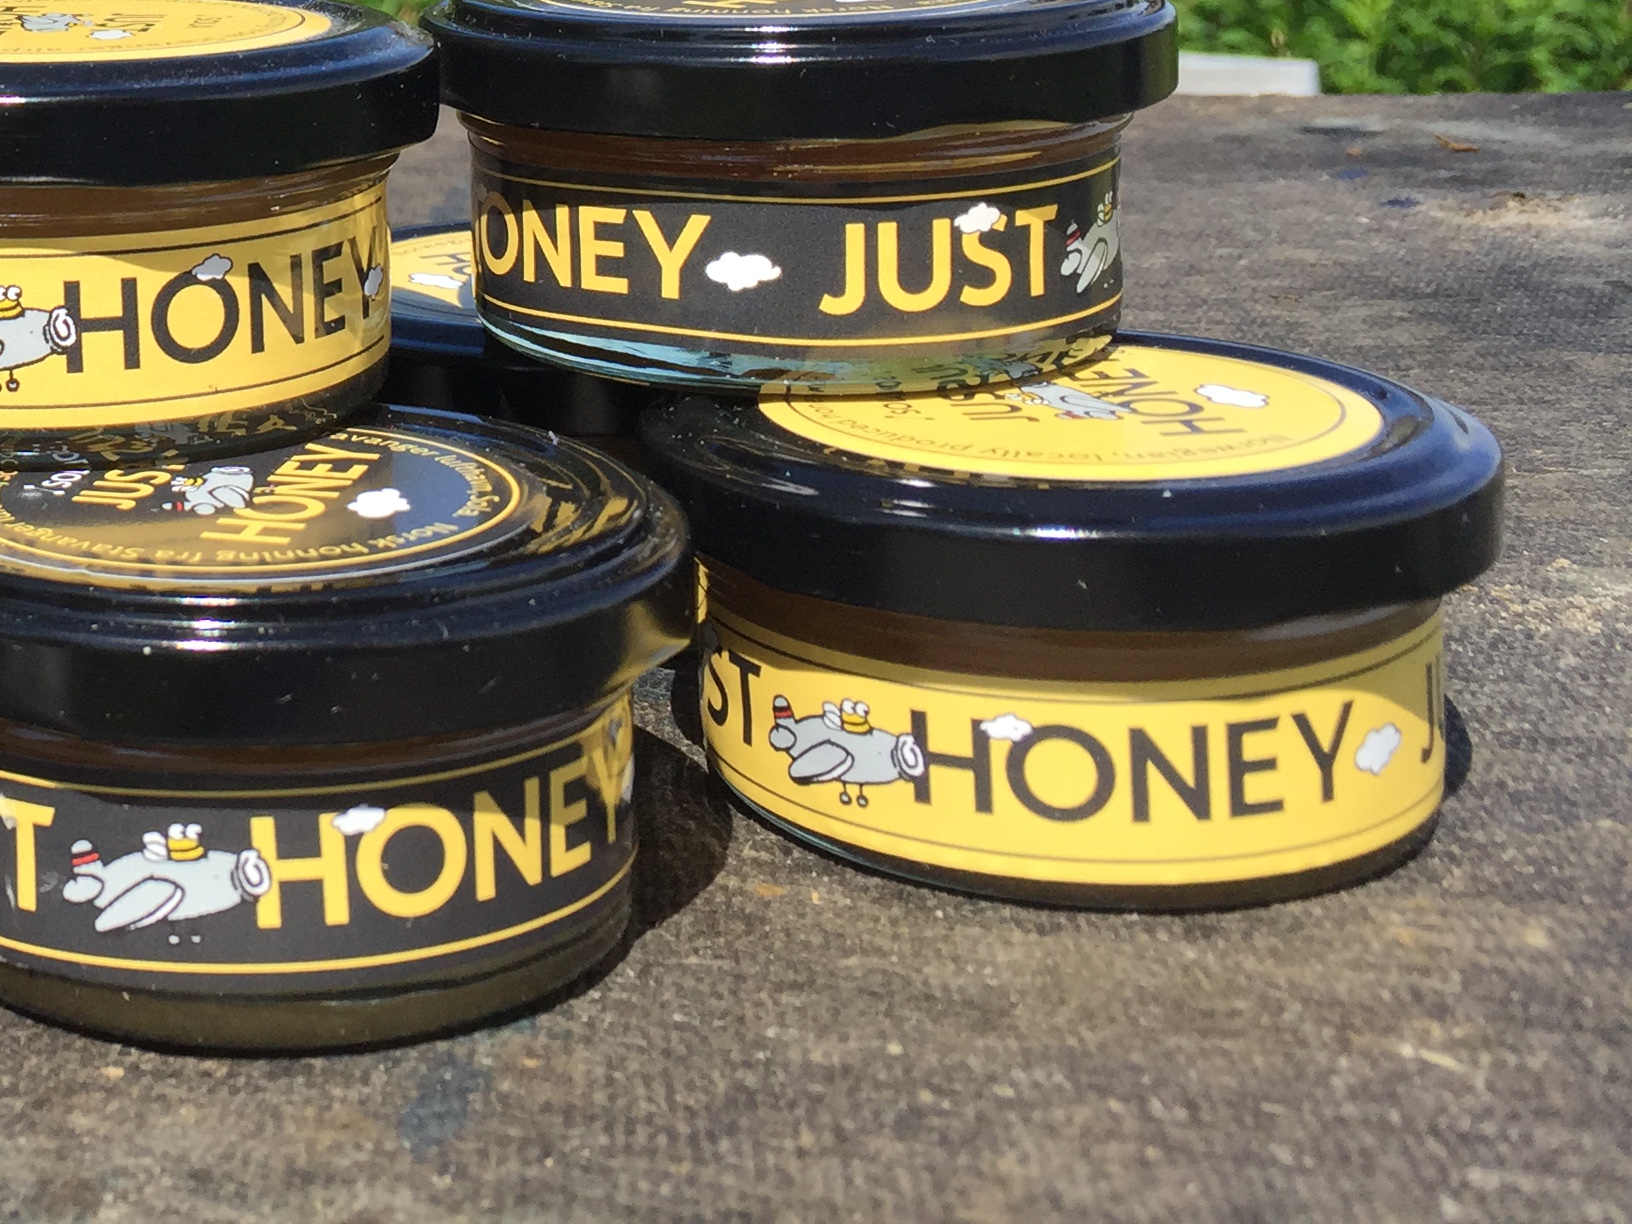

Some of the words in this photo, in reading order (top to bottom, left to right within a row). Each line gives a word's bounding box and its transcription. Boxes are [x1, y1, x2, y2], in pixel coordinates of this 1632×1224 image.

[475, 190, 712, 300] ONEY
[819, 203, 1059, 316] JUST
[64, 225, 378, 374] HONEY
[1066, 357, 1247, 437] HONE
[328, 432, 440, 458] avanger
[840, 417, 974, 452] produced
[71, 463, 186, 512] JUS
[199, 443, 382, 546] HONEY
[4, 522, 146, 560] Stavanger
[154, 549, 204, 563] fra
[216, 541, 369, 564] honning
[368, 521, 460, 550] Norsk
[911, 699, 1355, 824] HONEY
[249, 738, 627, 930] HONEY
